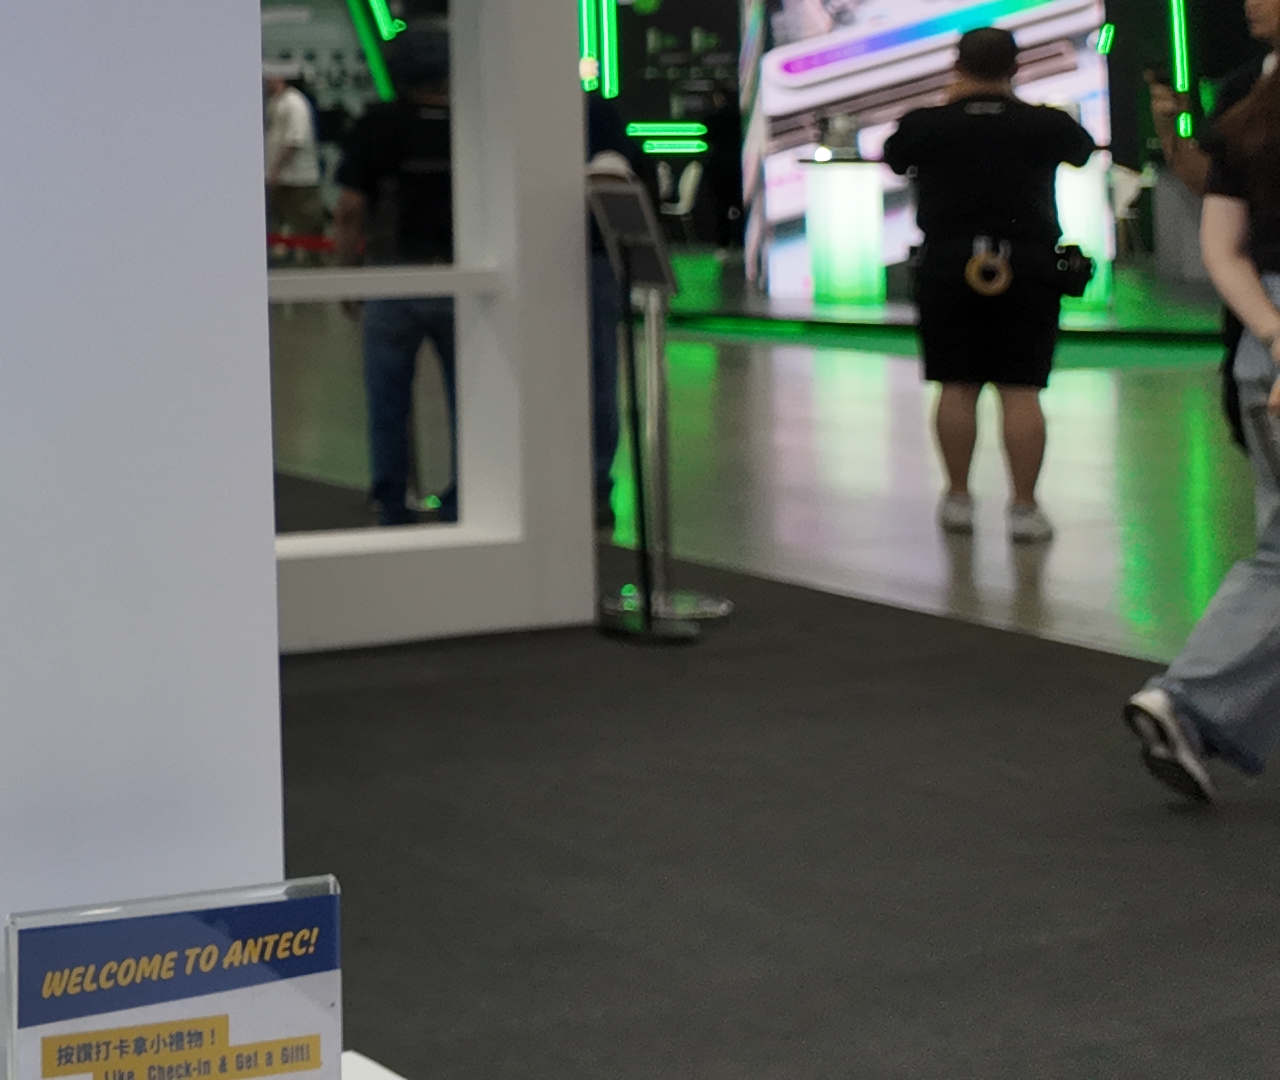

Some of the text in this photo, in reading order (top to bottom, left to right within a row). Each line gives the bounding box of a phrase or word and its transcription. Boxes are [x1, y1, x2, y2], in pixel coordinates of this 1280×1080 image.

[42, 927, 319, 998] WELCOME TO ANTEC!
